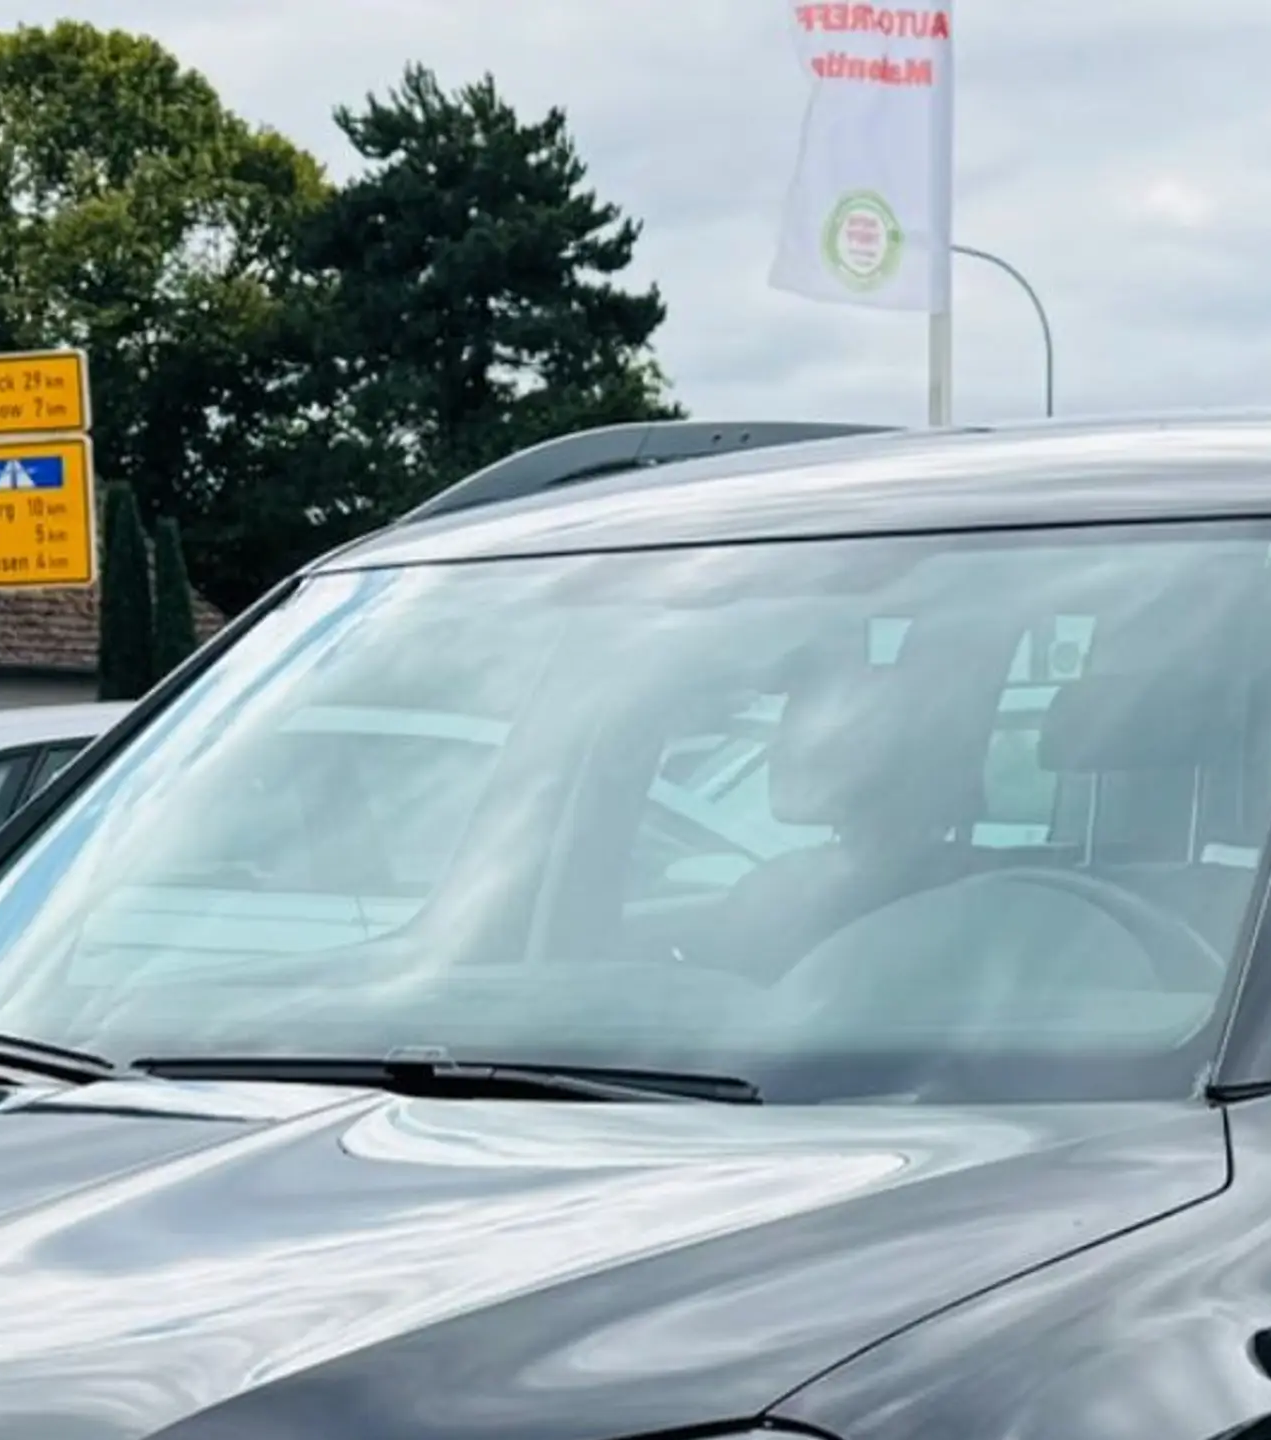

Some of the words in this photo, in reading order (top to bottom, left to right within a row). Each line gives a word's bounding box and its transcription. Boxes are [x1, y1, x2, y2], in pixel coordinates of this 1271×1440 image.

[45, 375, 65, 389] km
[33, 396, 44, 418] 7
[46, 403, 67, 417] km
[27, 497, 45, 517] 10
[47, 503, 68, 516] km
[35, 522, 45, 544] 5
[48, 528, 69, 542] km
[35, 551, 46, 569] 4
[48, 556, 69, 570] km
